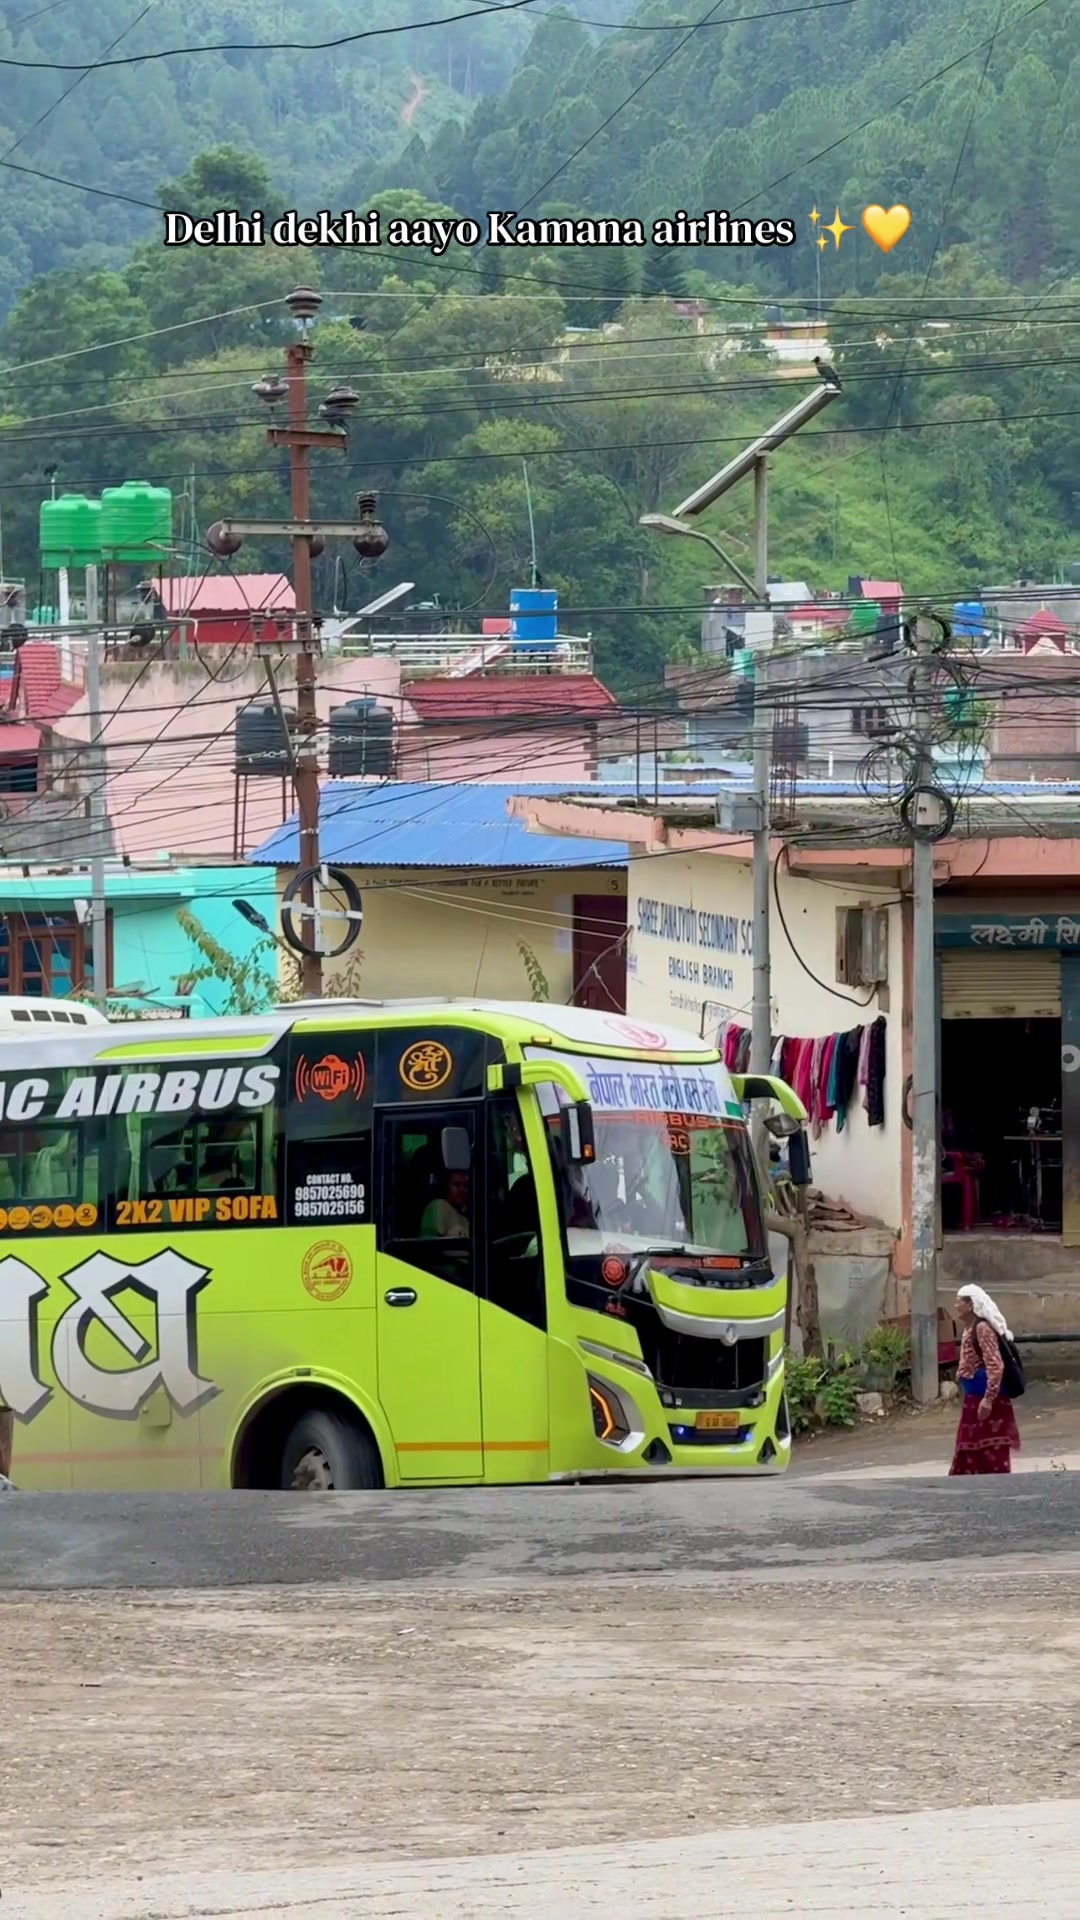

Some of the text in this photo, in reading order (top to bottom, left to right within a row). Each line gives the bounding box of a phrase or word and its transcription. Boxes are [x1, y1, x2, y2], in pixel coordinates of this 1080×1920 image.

[638, 896, 659, 934] SHREE
[699, 911, 739, 955] SECONDARY
[668, 956, 700, 985] ENGLISH
[702, 964, 734, 991] BRANCH
[0, 1064, 281, 1122] C AIRBUS
[586, 1061, 628, 1108] नेपाल
[627, 1072, 661, 1110] भारत
[634, 1112, 710, 1128] AIRBUS
[295, 1184, 365, 1202] 9857025690
[306, 1173, 354, 1186] CONTACT NO.
[116, 1195, 278, 1226] 2X2 VIP SOFA
[294, 1200, 365, 1218] 9857025156
